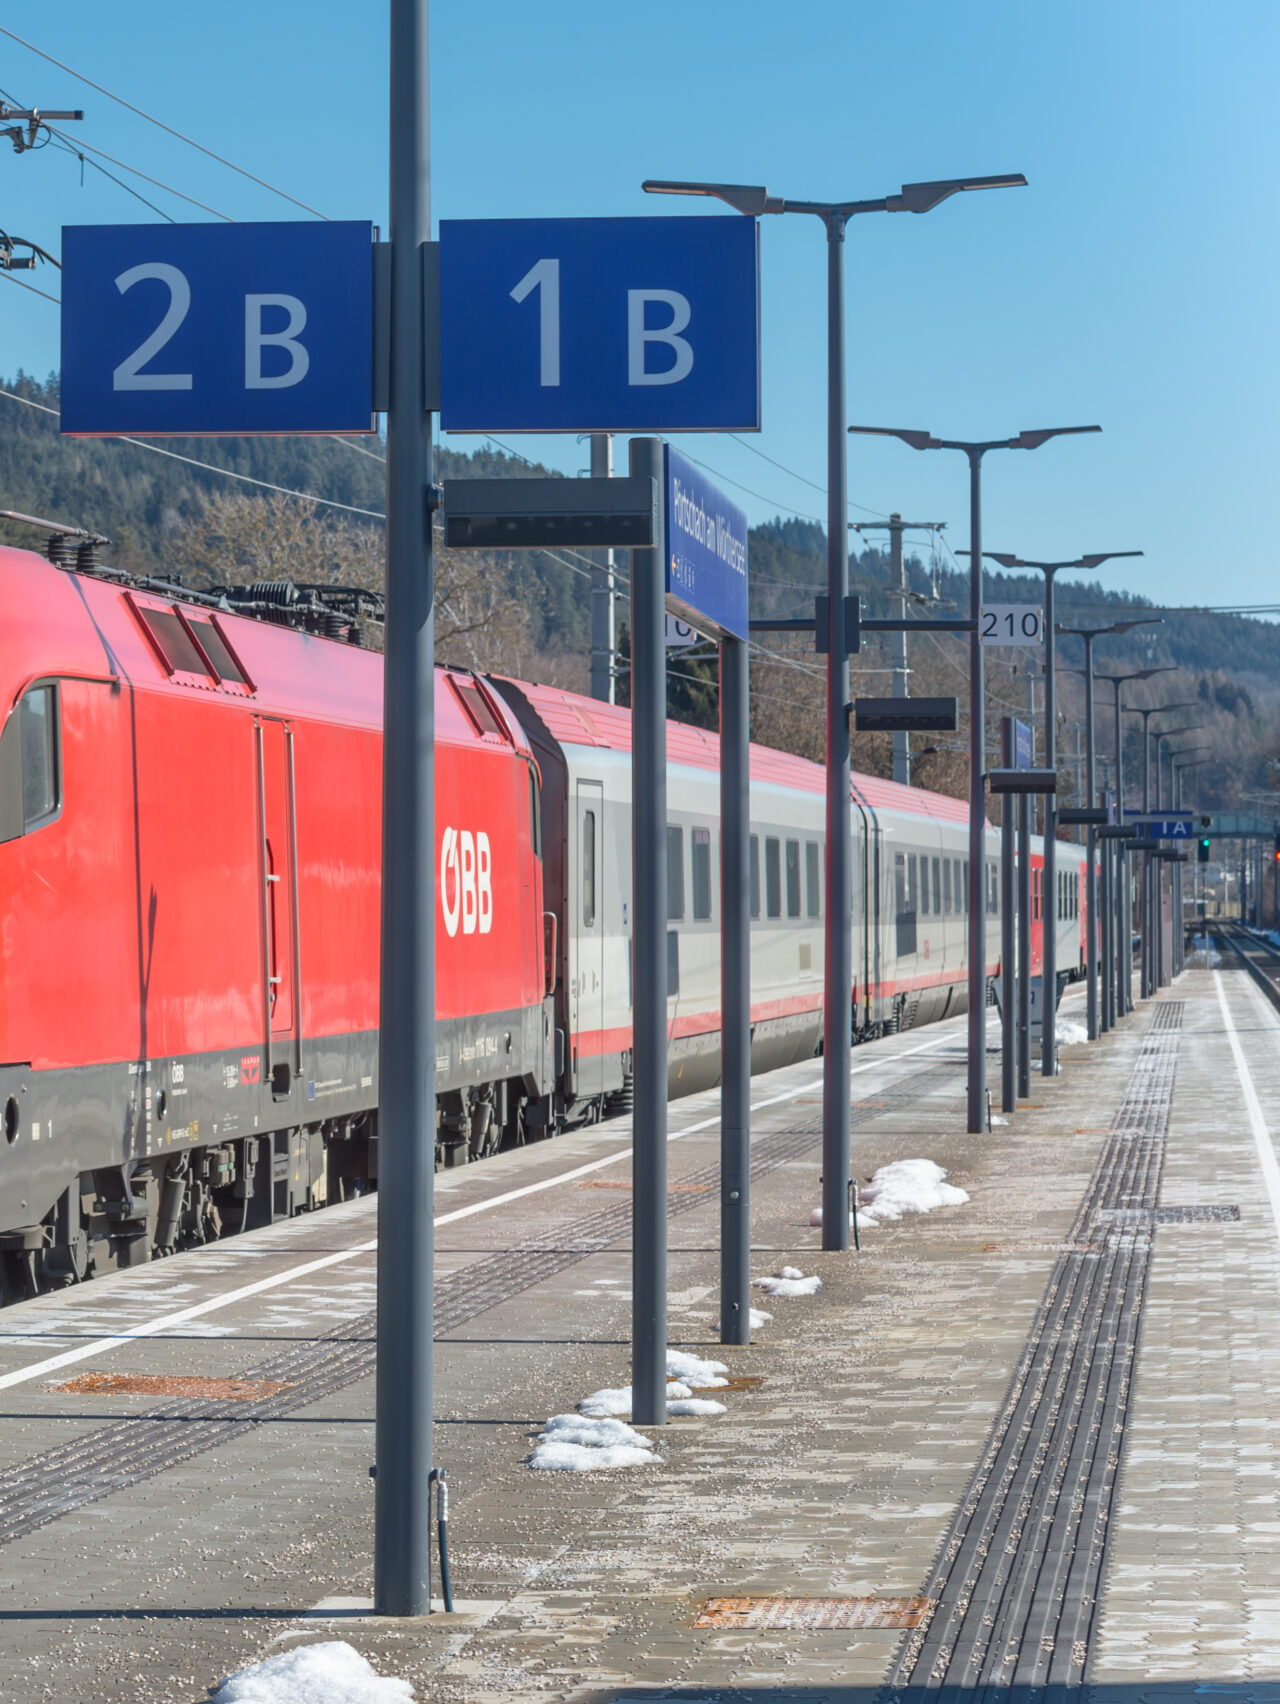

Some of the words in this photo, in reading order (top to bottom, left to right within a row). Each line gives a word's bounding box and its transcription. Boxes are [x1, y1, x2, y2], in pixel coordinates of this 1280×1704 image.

[113, 262, 193, 391] 2
[245, 293, 310, 389] B
[509, 258, 560, 387] 1
[628, 289, 694, 386] B
[673, 477, 706, 546] Pörtschach
[707, 516, 716, 553] am
[716, 512, 746, 577] Wörthersee
[982, 612, 1039, 637] 210
[1172, 821, 1187, 835] A
[440, 825, 493, 938] ÖBB
